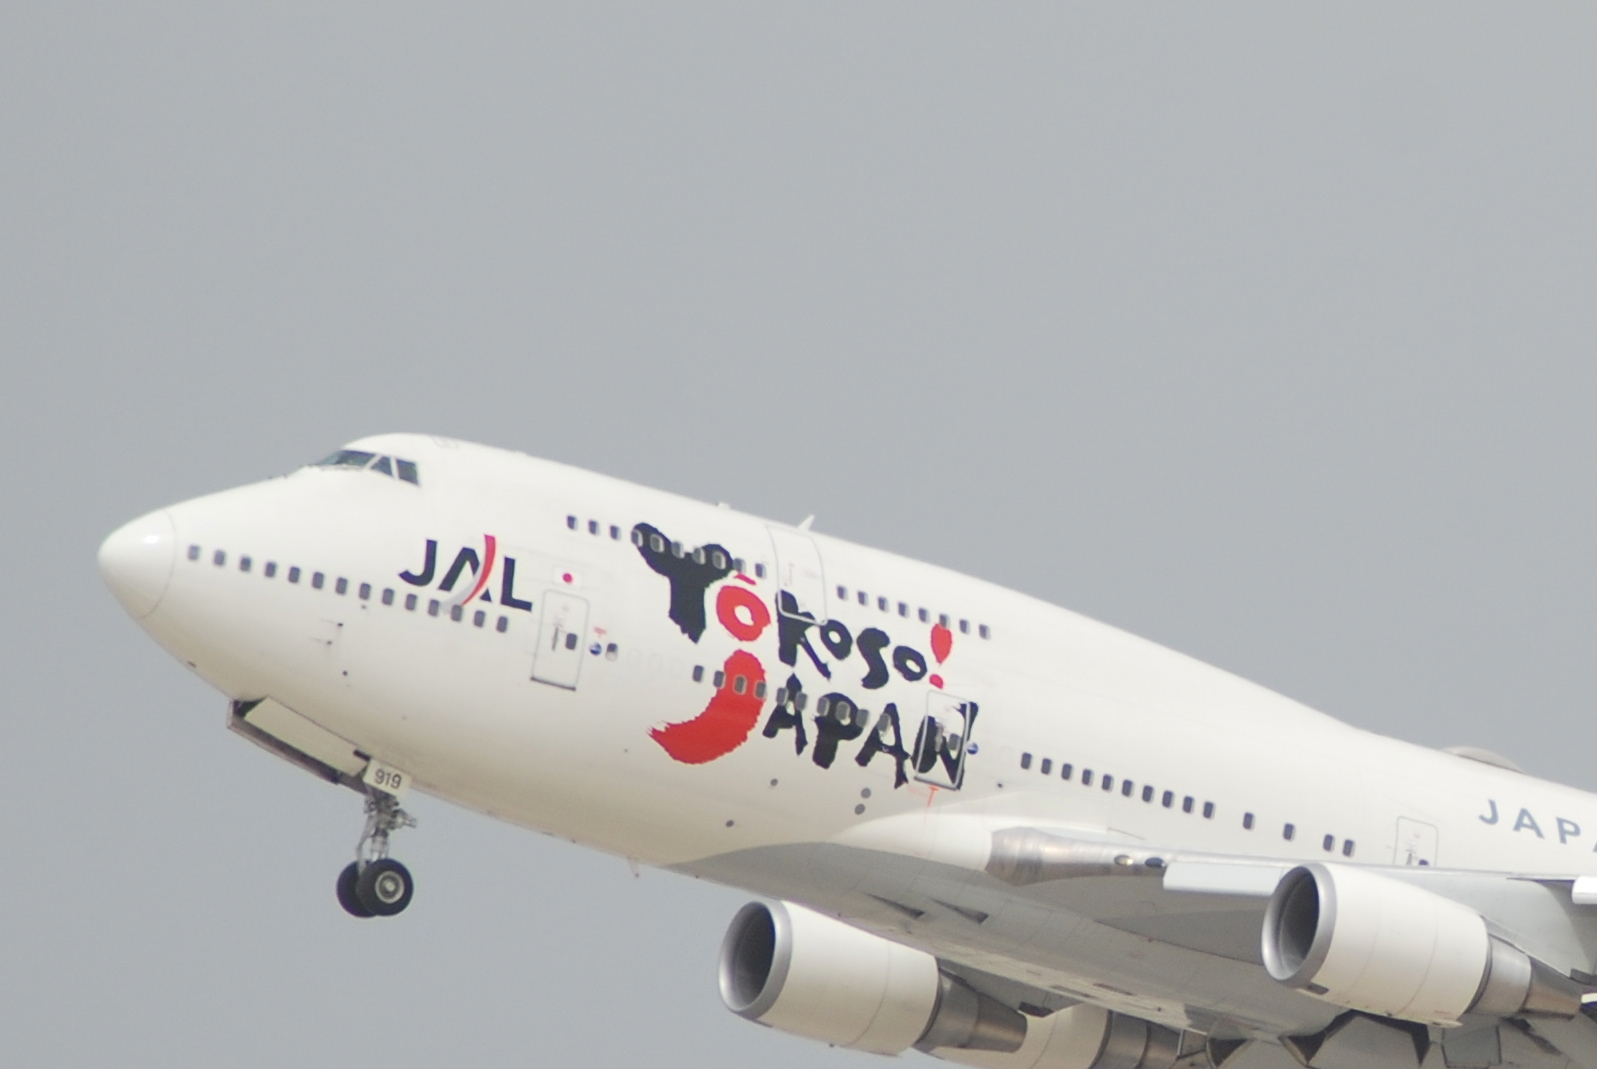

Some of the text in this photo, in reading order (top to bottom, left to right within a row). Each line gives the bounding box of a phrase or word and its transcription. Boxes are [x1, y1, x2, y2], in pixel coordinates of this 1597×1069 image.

[398, 534, 533, 612] JAL
[648, 648, 979, 791] JAPAN
[375, 769, 402, 789] 919
